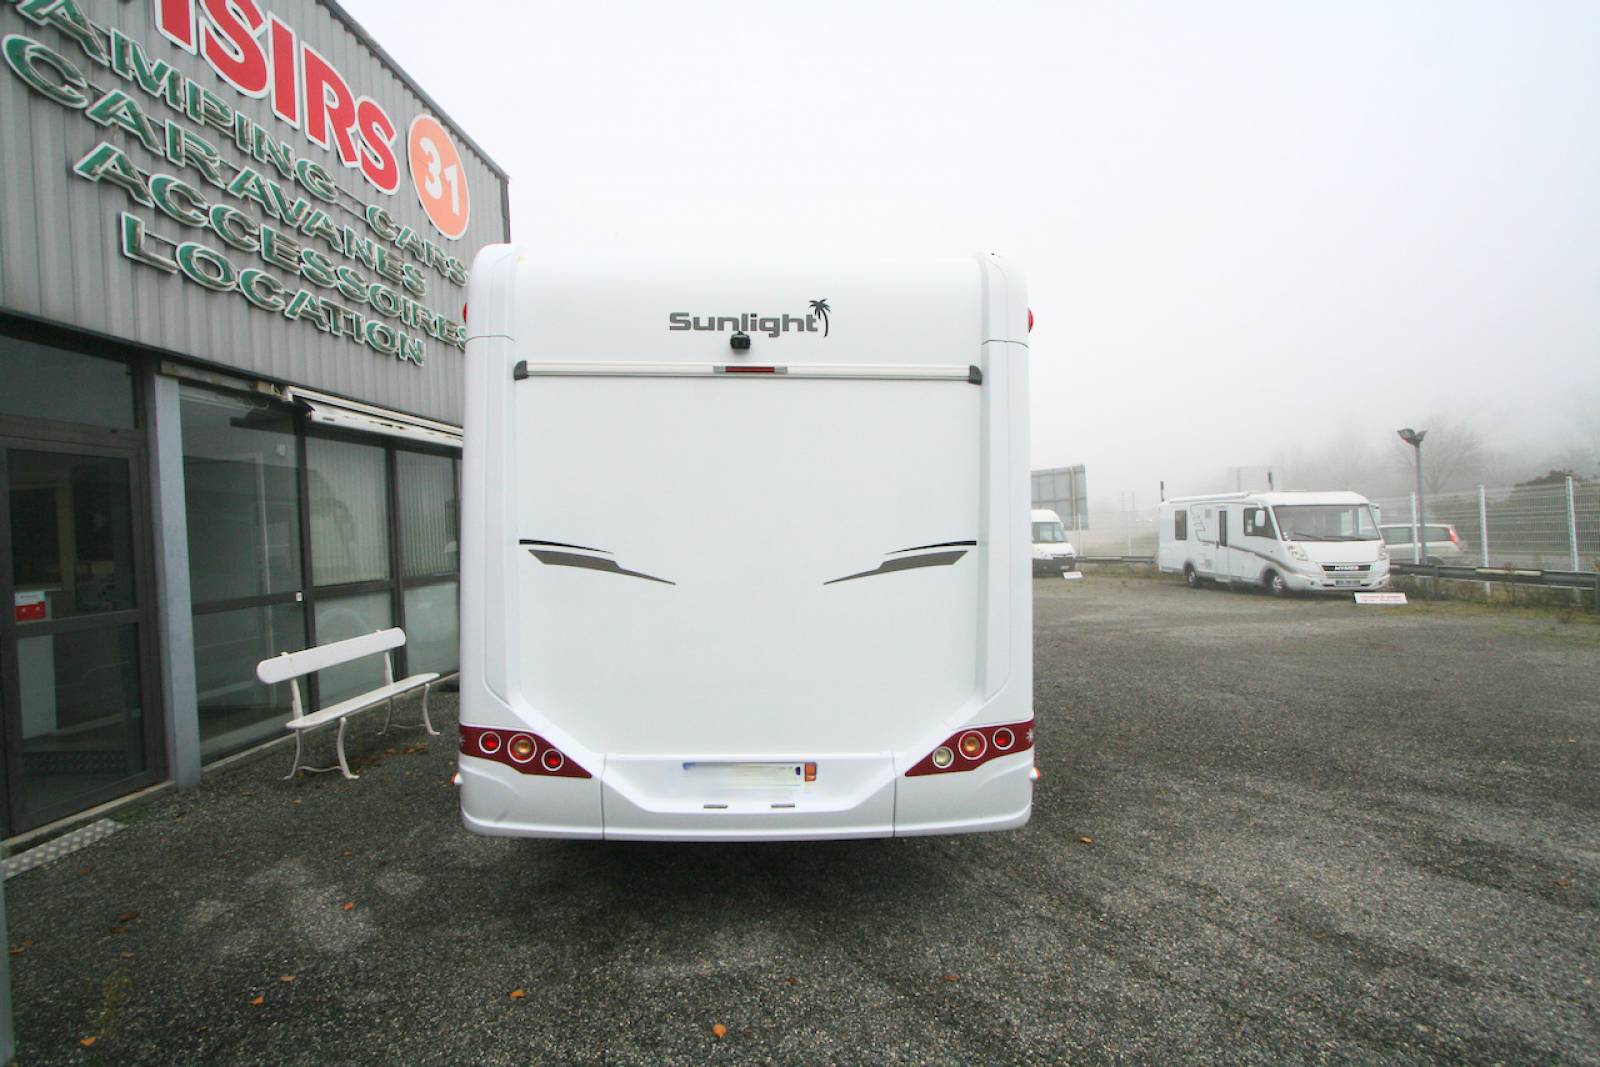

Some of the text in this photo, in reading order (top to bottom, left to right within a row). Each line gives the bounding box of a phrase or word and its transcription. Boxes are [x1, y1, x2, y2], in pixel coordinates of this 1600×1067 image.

[2, 34, 427, 297] CARAVANES
[12, 0, 469, 288] AMPING CARS
[420, 136, 460, 217] 31
[120, 211, 425, 367] LOCATION
[669, 312, 818, 338] Sunlight
